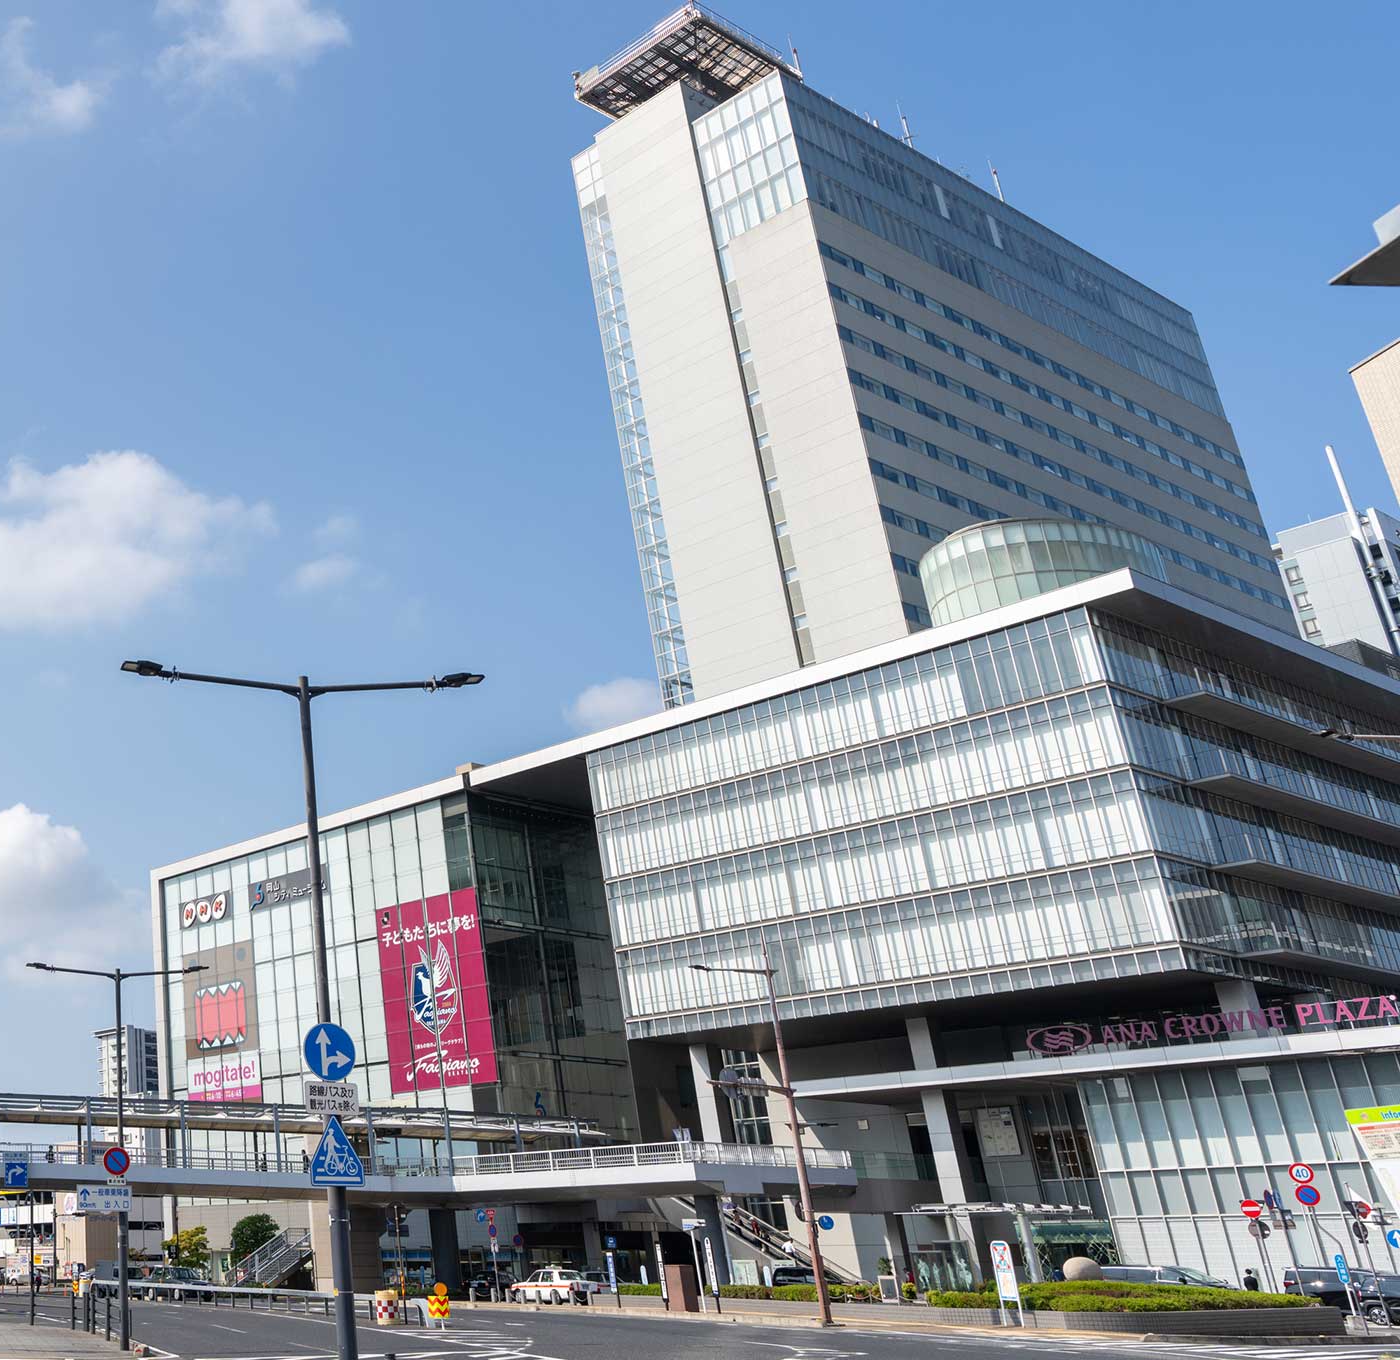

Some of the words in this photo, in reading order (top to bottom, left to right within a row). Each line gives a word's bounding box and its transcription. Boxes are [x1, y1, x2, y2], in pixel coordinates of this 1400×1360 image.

[265, 881, 281, 893] 岡山
[184, 897, 224, 922] NHK
[1103, 1022, 1158, 1045] ANA
[1164, 1006, 1288, 1039] CROWNE
[1296, 995, 1399, 1026] PLAZA
[194, 1060, 256, 1088] mogitate!
[309, 1085, 354, 1098] 路線バス及び
[309, 1099, 355, 1111] 観光バスを除く
[1295, 1168, 1309, 1179] 40
[104, 1200, 129, 1209] 出入口
